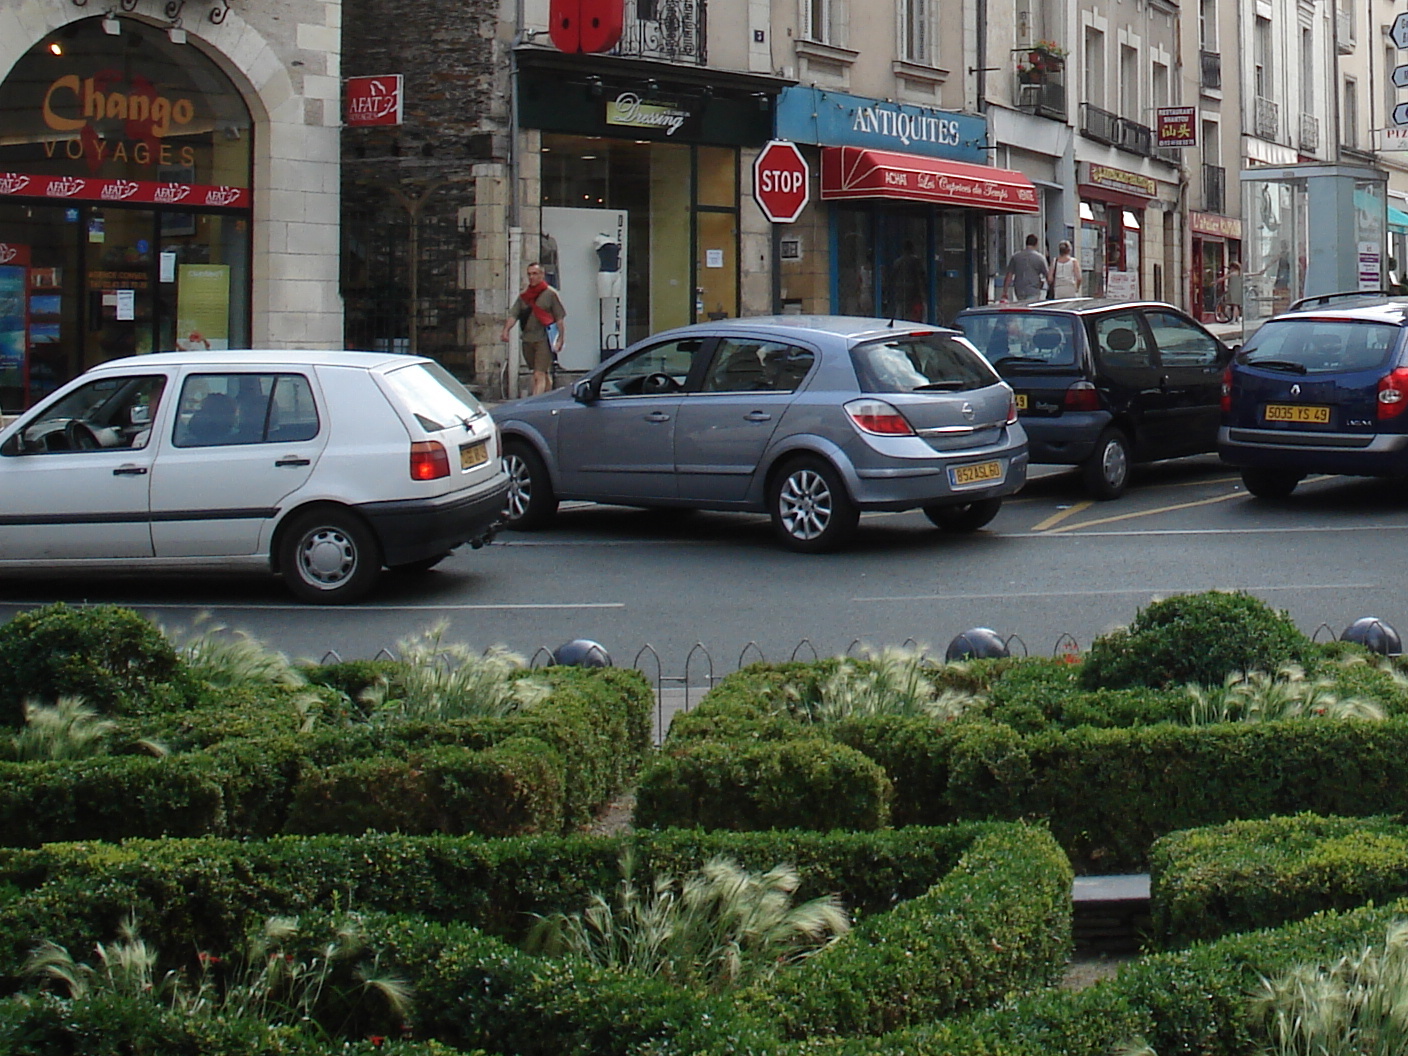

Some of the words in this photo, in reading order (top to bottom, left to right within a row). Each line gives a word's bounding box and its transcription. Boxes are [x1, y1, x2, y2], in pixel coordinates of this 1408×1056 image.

[43, 74, 194, 138] Chango
[351, 96, 382, 113] AFAT
[613, 92, 684, 136] Dressing
[853, 106, 960, 146] ANTIQUITES
[44, 139, 194, 167] VOYAGES
[47, 181, 69, 192] AFAT
[101, 185, 123, 196] AFAT
[154, 187, 176, 198] AFAT
[206, 191, 228, 201] AFAT
[762, 169, 803, 193] STOP
[885, 172, 908, 186] ACHAT
[918, 172, 935, 189] Les
[936, 173, 971, 195] Caprices
[972, 183, 982, 194] du
[983, 182, 1008, 201] Temps
[1017, 189, 1035, 201] VENTE
[1268, 407, 1293, 419] 5035
[1298, 407, 1310, 419] YS
[1314, 408, 1327, 421] 49
